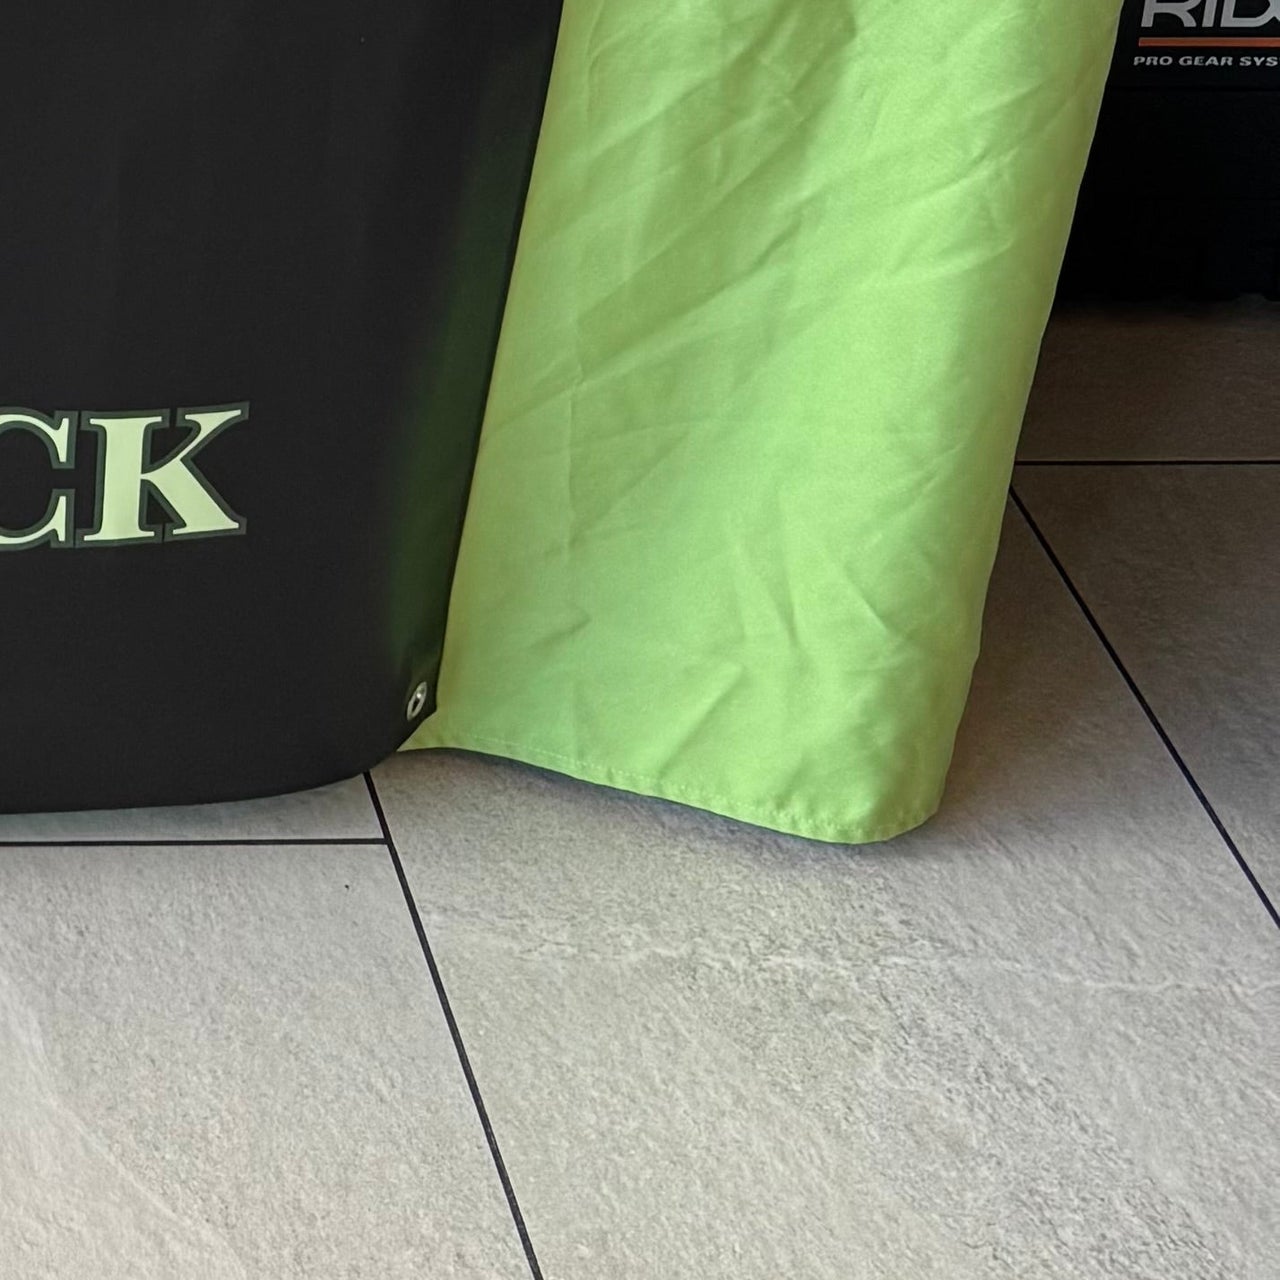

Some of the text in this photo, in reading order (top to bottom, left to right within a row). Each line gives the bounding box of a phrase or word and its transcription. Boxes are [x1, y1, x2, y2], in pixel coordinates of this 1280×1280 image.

[1133, 56, 1280, 67] PRO GEAR SYS
